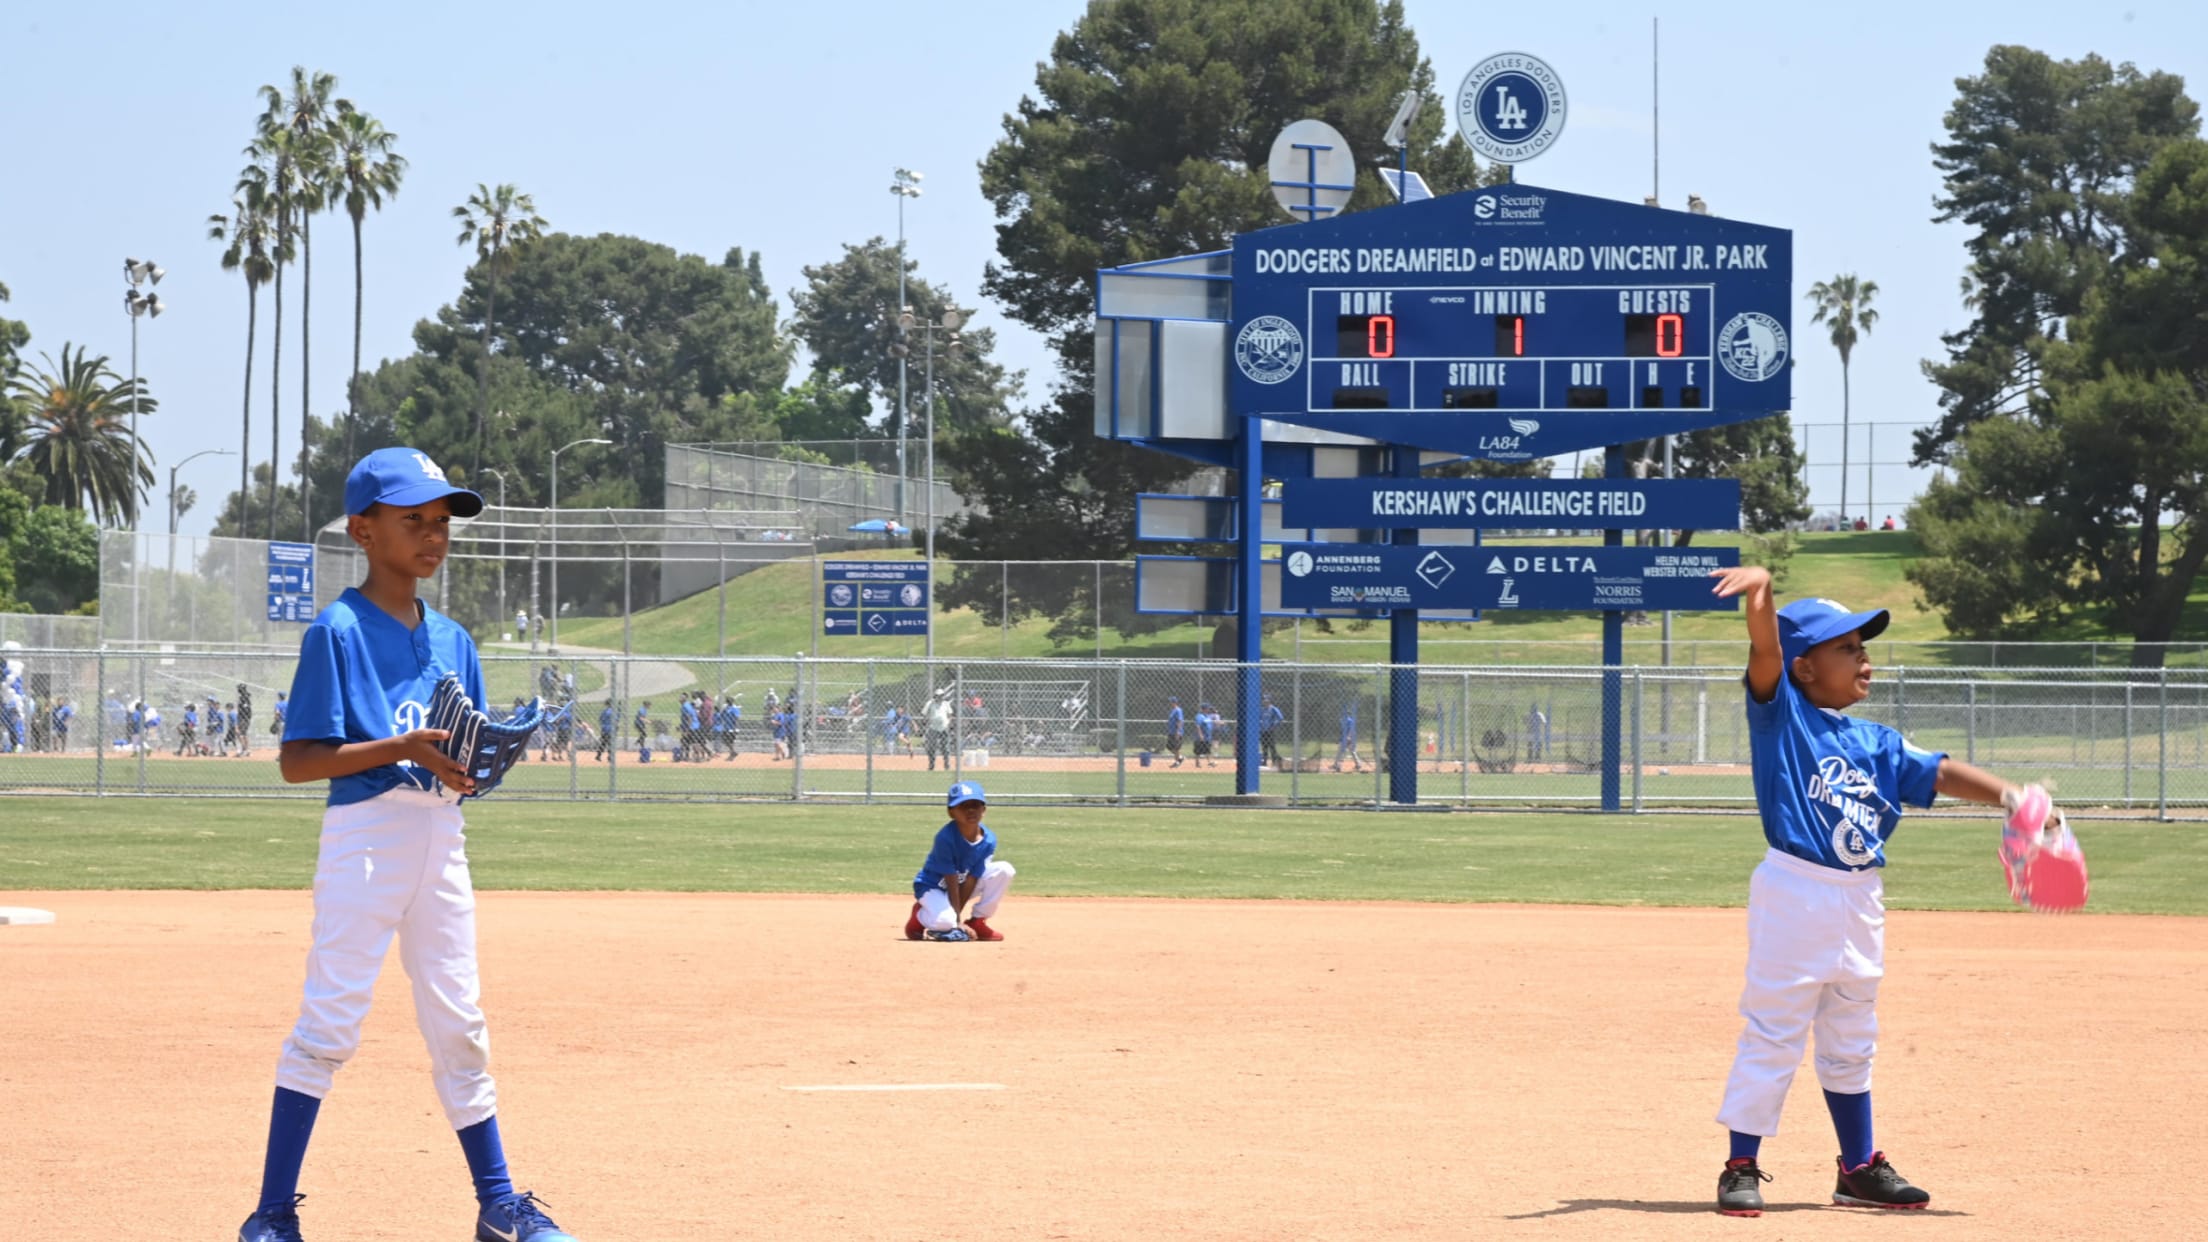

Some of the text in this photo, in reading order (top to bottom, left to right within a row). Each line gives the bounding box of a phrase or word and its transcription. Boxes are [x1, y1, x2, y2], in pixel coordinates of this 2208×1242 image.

[1462, 58, 1561, 115] LOS ANGELES DODGERS
[1495, 86, 1528, 129] LA
[1469, 129, 1553, 157] FOUNDATION
[1500, 194, 1548, 208] Security
[1500, 207, 1541, 218] Benefit
[1256, 244, 1768, 273] DODGERS DREAMFIELD at EDWARD VINCENT JR. PARK
[1340, 291, 1393, 315] HOME
[1474, 290, 1546, 314] INNING
[1618, 290, 1691, 314] GUESTS
[1368, 315, 1394, 358] 0
[1514, 317, 1523, 356] 1
[1656, 314, 1683, 357] 0
[1341, 363, 1380, 386] BALL
[1448, 363, 1506, 386] STRIKE
[1571, 362, 1603, 385] OUT
[1648, 362, 1658, 385] H
[1686, 362, 1695, 385] E
[1479, 435, 1520, 449] LA84
[1372, 490, 1647, 516] KERSHAW'S CHALLENGE FIELD
[1315, 555, 1381, 564] ANNENBERG
[1315, 565, 1381, 573] FOUNDATION
[1513, 556, 1598, 573] DELTA
[1655, 555, 1719, 566] HELEN AND WILL
[1643, 566, 1677, 577] WEBSTER
[1331, 586, 1411, 597] SAN MANUEL
[1595, 585, 1642, 596] NORRIS
